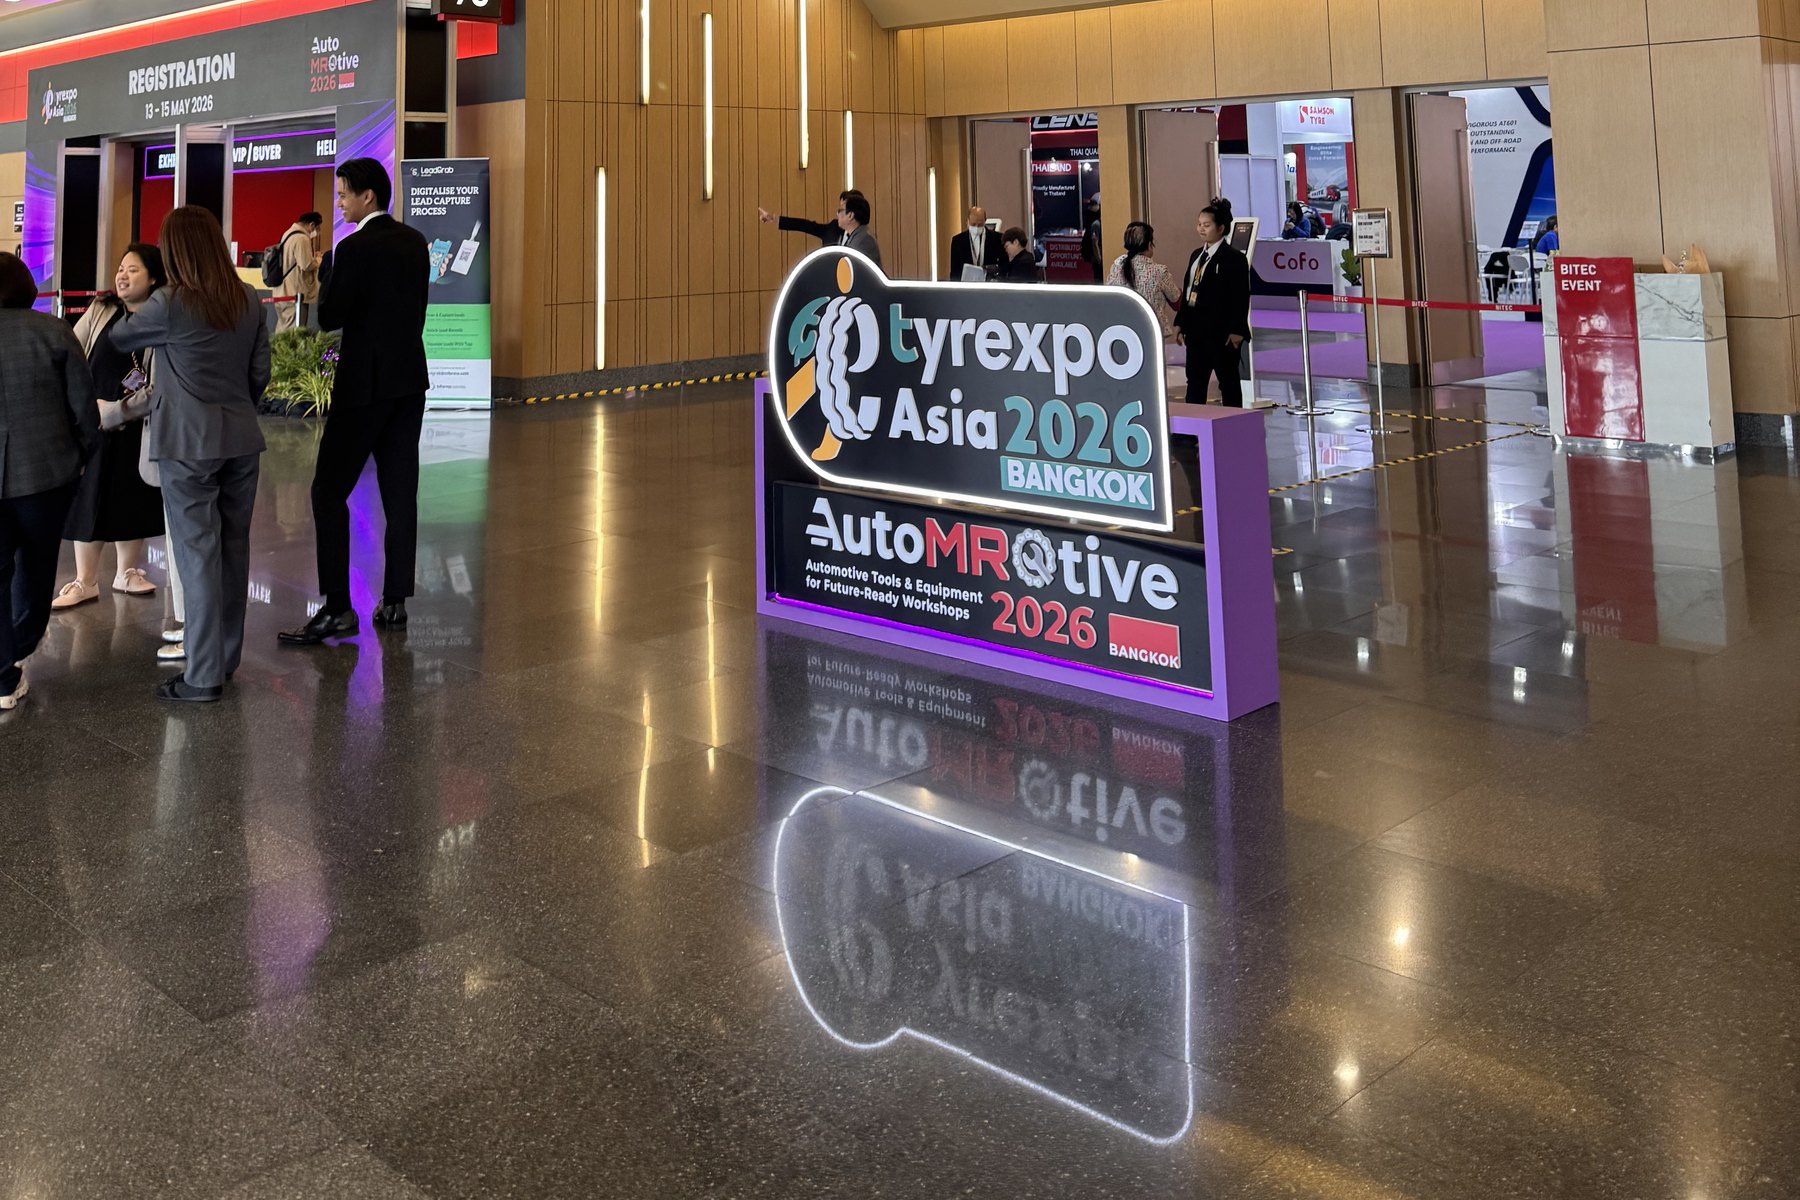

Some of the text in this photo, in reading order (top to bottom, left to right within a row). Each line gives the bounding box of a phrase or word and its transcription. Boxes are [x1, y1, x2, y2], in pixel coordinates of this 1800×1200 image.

[311, 36, 340, 54] Auto
[128, 52, 236, 95] REGISTRATION
[310, 74, 337, 93] 2026
[145, 103, 154, 119] 13
[161, 100, 170, 117] 15
[170, 98, 191, 116] MAY
[191, 94, 214, 113] 2026
[1309, 106, 1335, 115] SAMSON
[1310, 116, 1326, 125] TYRE
[1470, 129, 1515, 137] OUTSTANDING
[1069, 148, 1084, 157] THAI
[1470, 146, 1516, 154] PERFORMANCE
[410, 186, 479, 196] DIGITALISE YOUR
[410, 196, 471, 206] LEAD CAPTURE
[410, 207, 447, 216] PROCESS
[1273, 251, 1319, 271] Cofo
[1560, 264, 1597, 275] BITEC
[1561, 279, 1602, 291] EVENT
[890, 303, 1144, 396] tyrexpo
[888, 387, 1153, 468] Asia 2026
[1006, 458, 1148, 506] BANGKOK
[805, 558, 983, 605] Automotive Tools & Equipment
[805, 574, 970, 621] for Future-Ready Workshops
[990, 591, 1098, 649] 2026
[1109, 642, 1181, 669] BANGKOK
